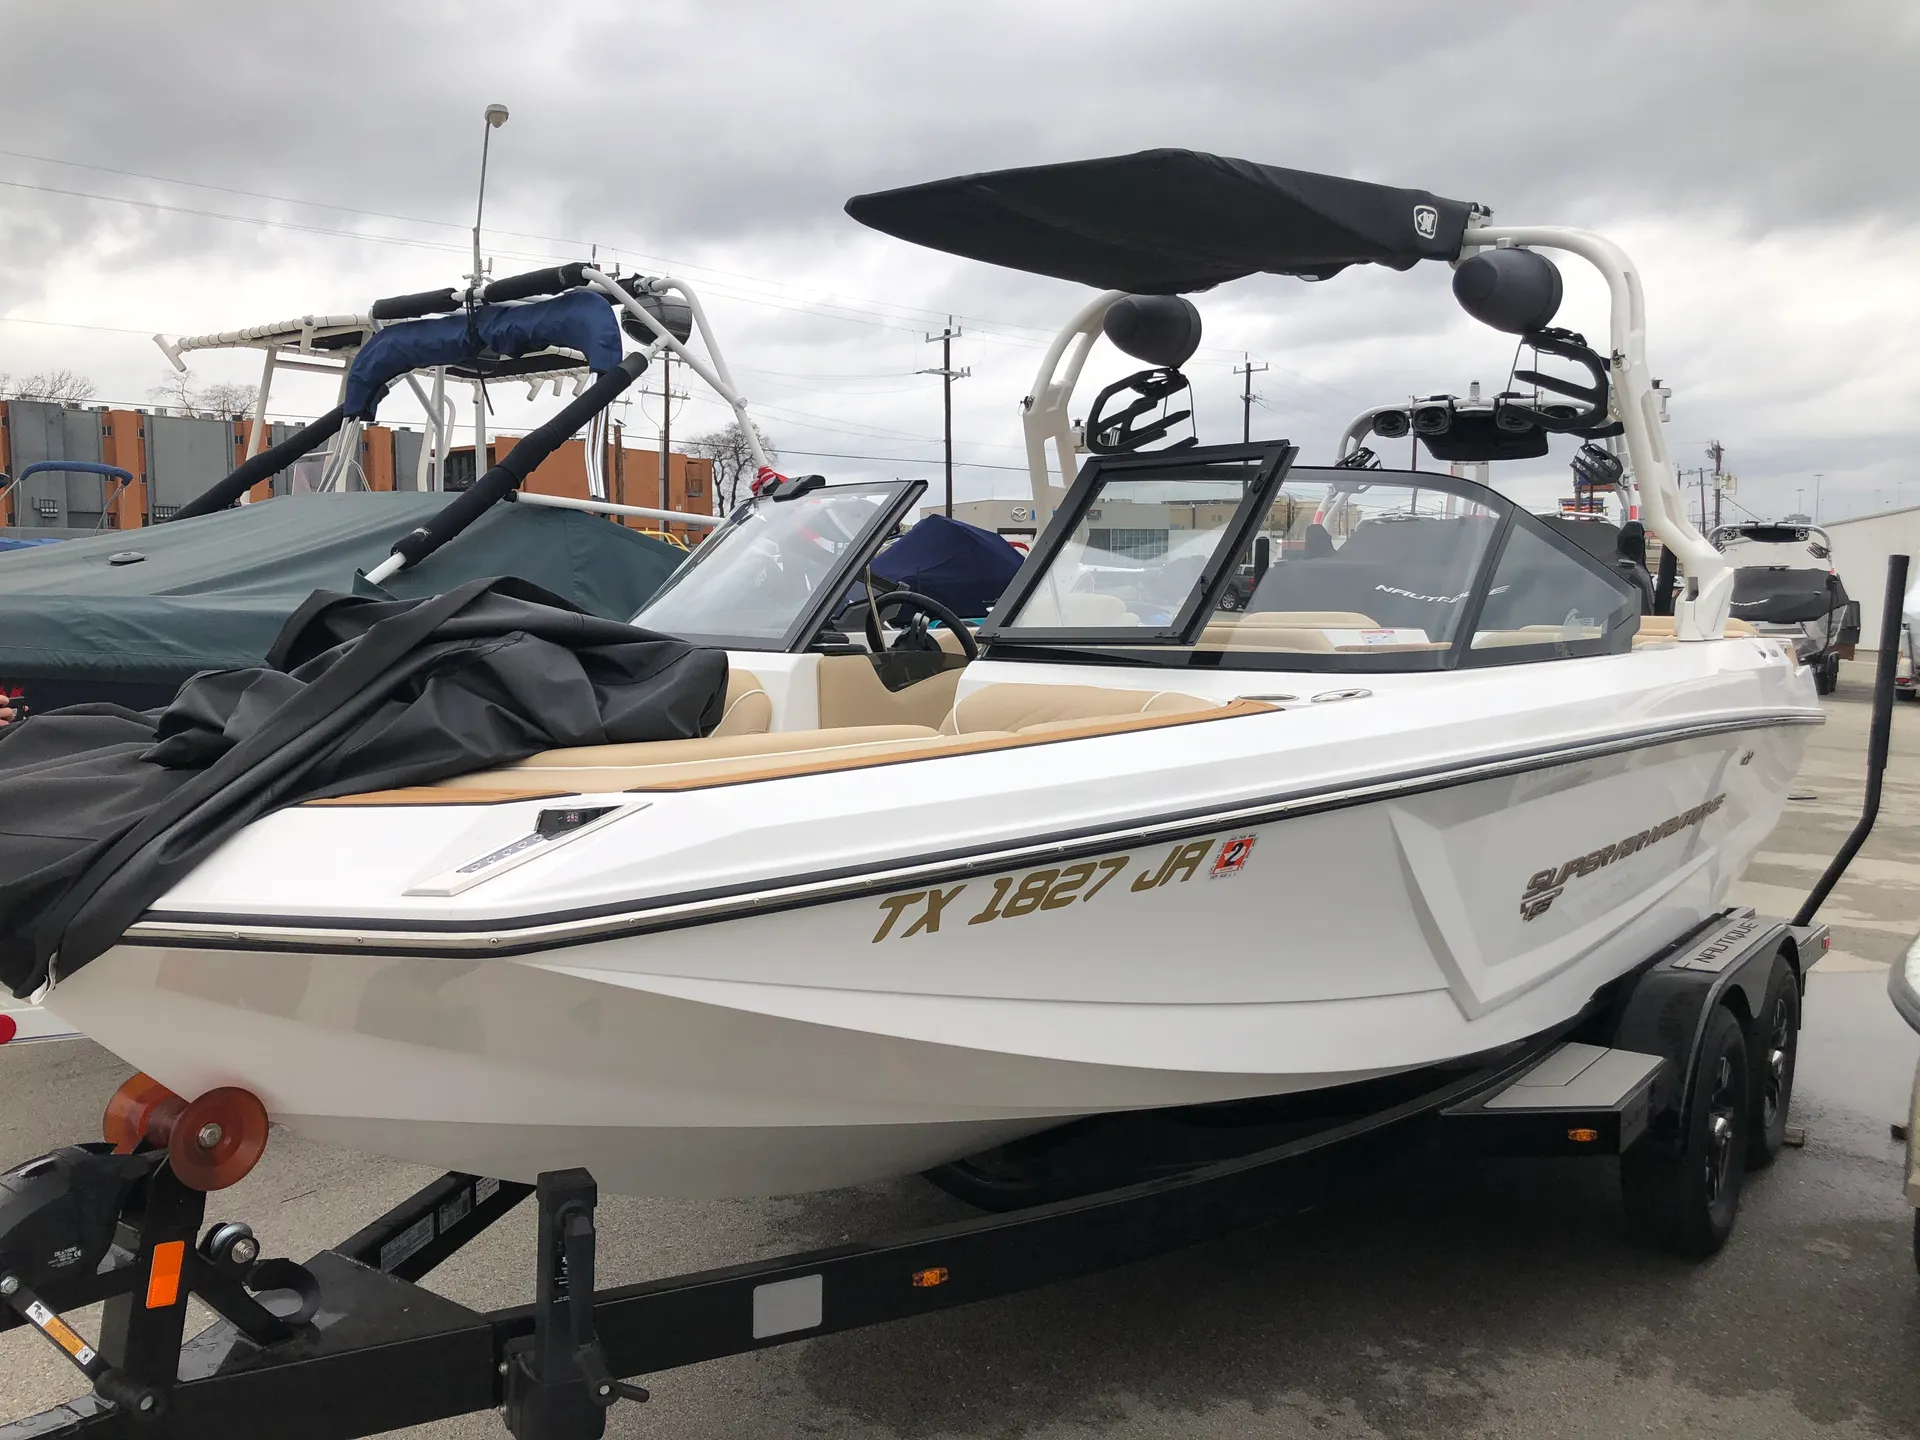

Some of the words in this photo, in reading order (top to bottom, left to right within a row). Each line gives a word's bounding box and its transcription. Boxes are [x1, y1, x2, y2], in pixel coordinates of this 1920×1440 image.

[1223, 841, 1245, 868] 2
[871, 884, 968, 944] TX
[967, 856, 1131, 926] 1827
[1130, 838, 1217, 893] JA
[1693, 919, 1759, 964] NAUTIQUE
